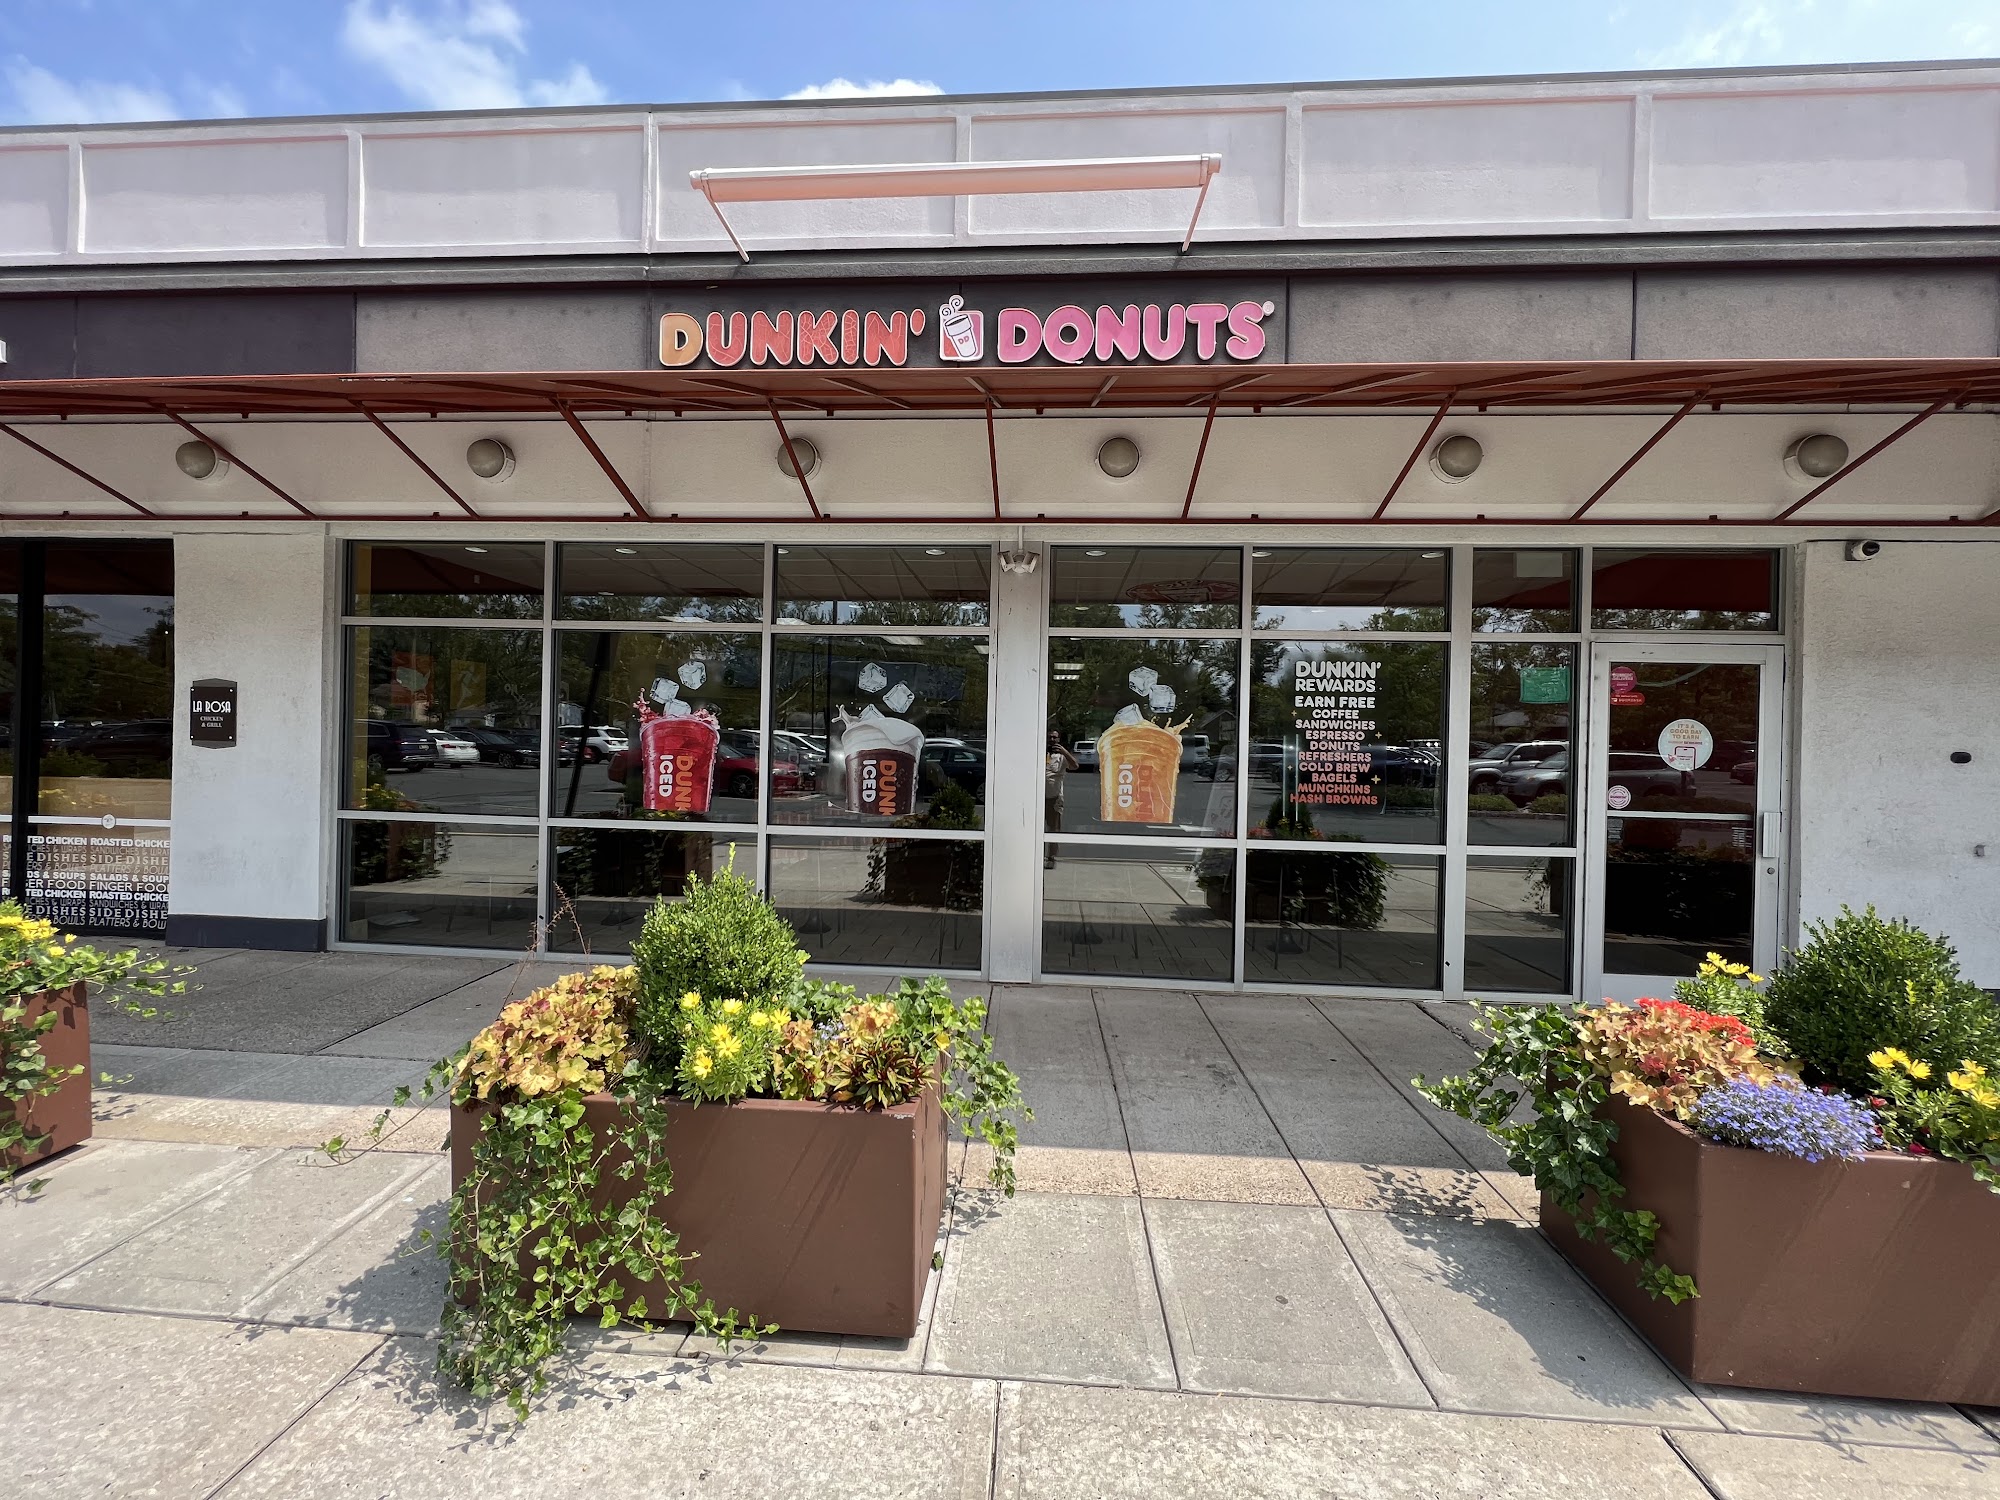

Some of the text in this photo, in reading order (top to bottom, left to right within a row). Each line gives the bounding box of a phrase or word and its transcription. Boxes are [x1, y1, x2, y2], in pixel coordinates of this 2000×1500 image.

[659, 309, 926, 366] DUNKIN'
[1295, 661, 1381, 679] DUNKIN'
[1295, 679, 1376, 693] REWARDS
[192, 700, 231, 713] LA ROSA
[1295, 695, 1376, 709] EARN FREE
[1312, 709, 1360, 719] COFFEE
[1295, 719, 1376, 731] SANDWICHES
[1305, 730, 1366, 741] ESPRESSO
[1310, 741, 1360, 751] DONUTS
[1298, 752, 1372, 762] REFRESHERS
[1299, 762, 1370, 773] COLD BREW
[659, 754, 673, 797] ICED
[863, 760, 877, 802] ICED
[1312, 773, 1357, 783] BAGELS
[1118, 764, 1133, 808] ICED
[1297, 783, 1371, 794] MUNCHKINS
[1290, 793, 1378, 805] HASH BROWNS
[46, 836, 87, 846] CHICKEN
[90, 837, 133, 847] ROASTED
[91, 847, 140, 856] SANDWICHES
[37, 852, 87, 863] DISHES
[90, 854, 122, 864] SIDE
[43, 871, 49, 879] &
[53, 871, 86, 880] SOUPS
[90, 873, 128, 881] SALADS
[132, 874, 139, 882] &
[47, 879, 86, 890] FOOD
[90, 881, 133, 892] FINGER
[137, 882, 169, 893] FOO
[45, 889, 86, 899] CHICKEN
[90, 891, 133, 900] ROASTED
[89, 899, 139, 909] SANDWICHES
[36, 905, 86, 916] DISHES
[89, 907, 121, 918] SIDE
[89, 917, 130, 927] PLATTERS
[133, 919, 140, 927] &
